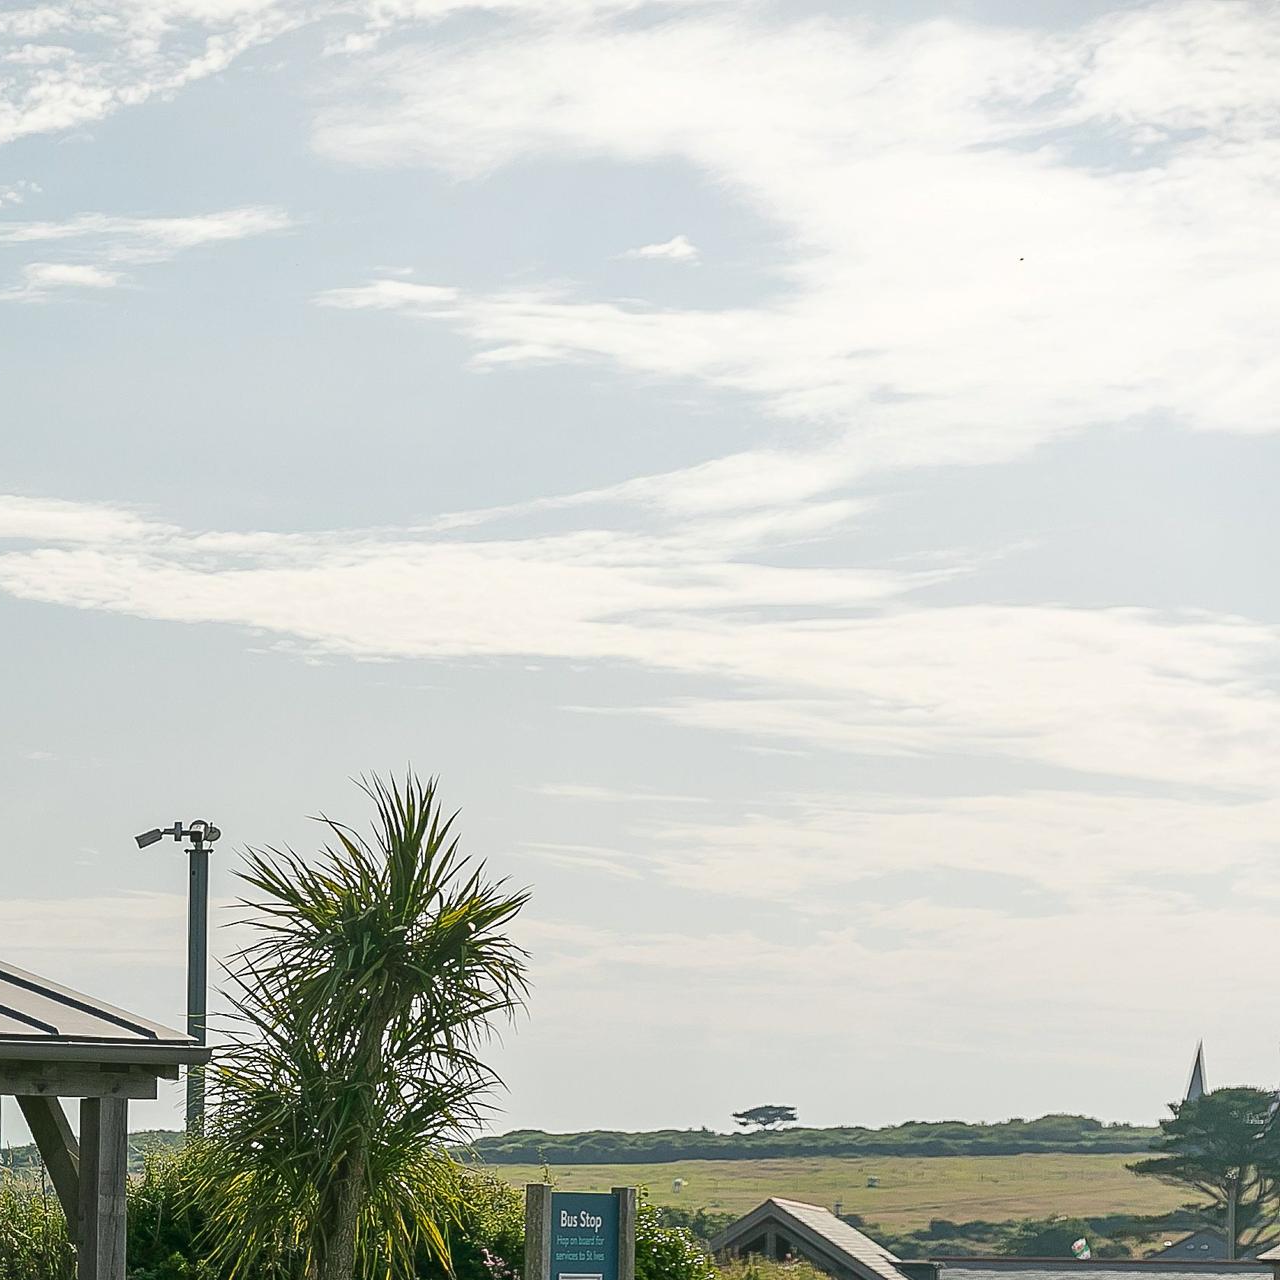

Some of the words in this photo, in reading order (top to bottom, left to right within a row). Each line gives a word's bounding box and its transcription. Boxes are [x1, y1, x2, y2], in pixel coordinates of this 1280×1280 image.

[560, 1210, 578, 1228] Bus
[580, 1210, 602, 1233] Stop
[556, 1235, 569, 1248] Hop
[570, 1237, 578, 1245] on
[578, 1235, 595, 1246] board
[595, 1235, 605, 1246] for
[555, 1250, 578, 1261] services
[579, 1250, 586, 1261] to
